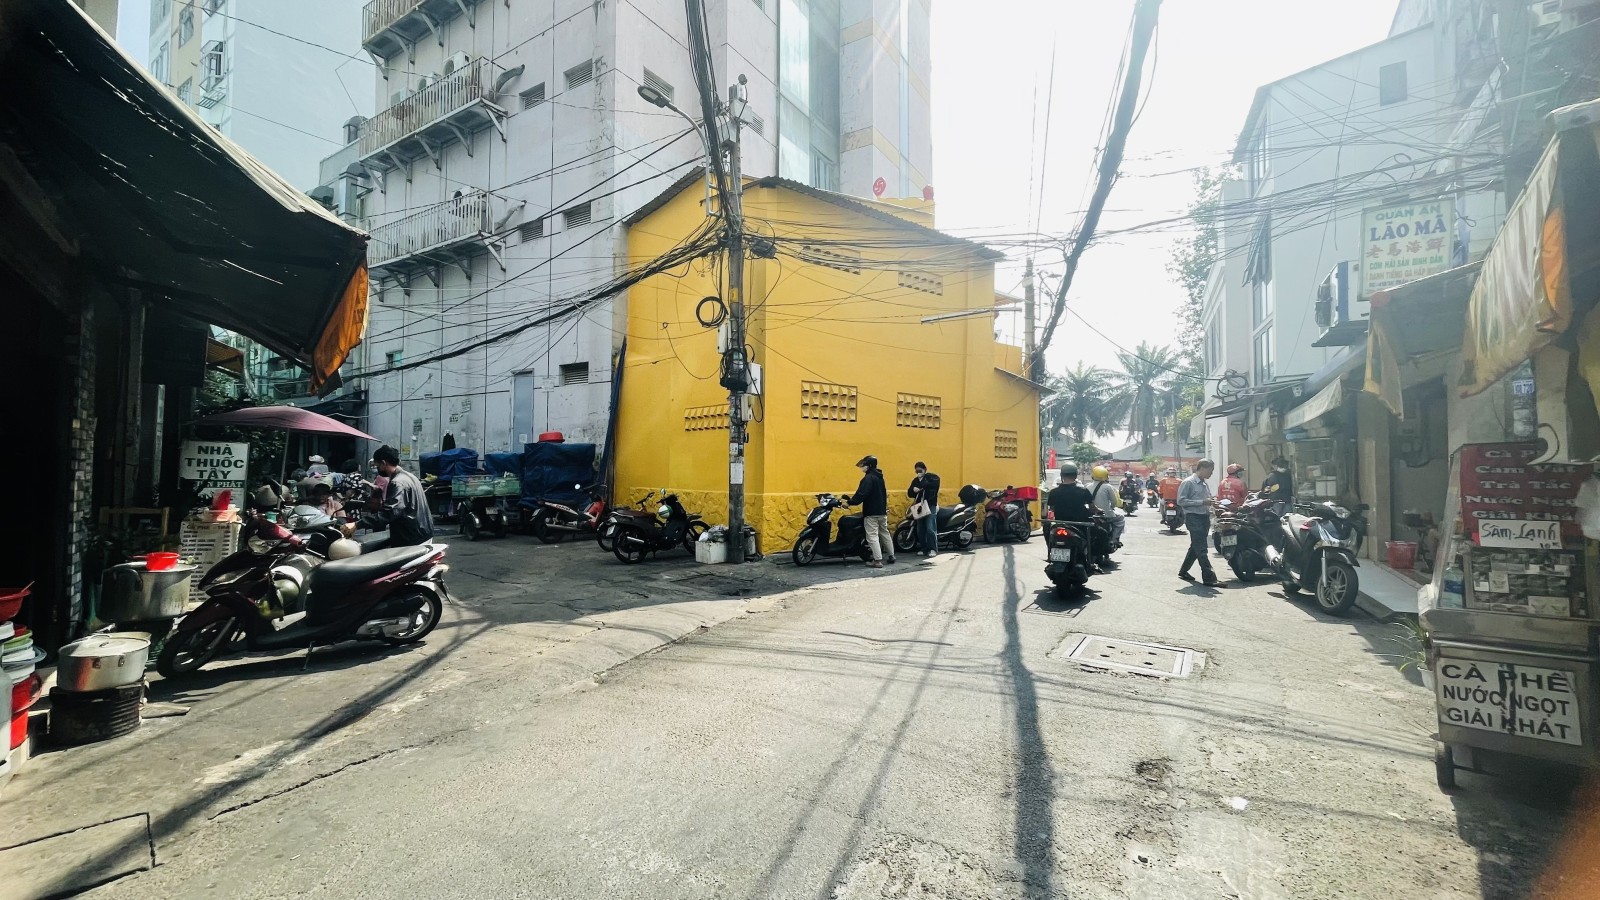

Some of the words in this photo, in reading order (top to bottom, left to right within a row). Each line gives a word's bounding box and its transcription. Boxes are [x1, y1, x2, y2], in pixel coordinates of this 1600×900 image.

[1370, 221, 1410, 241] LÃO
[1414, 214, 1447, 236] MÃ
[184, 456, 244, 469] THUỐC
[197, 444, 233, 456] NHÀ
[196, 467, 231, 480] TÂY
[1441, 662, 1488, 683] CÀ
[1498, 668, 1570, 693] PHÊ
[1443, 684, 1507, 711] NƯỚC
[1511, 692, 1571, 718] NGỌT
[1446, 706, 1493, 728] GIẢI
[1500, 714, 1571, 740] KHÁT
